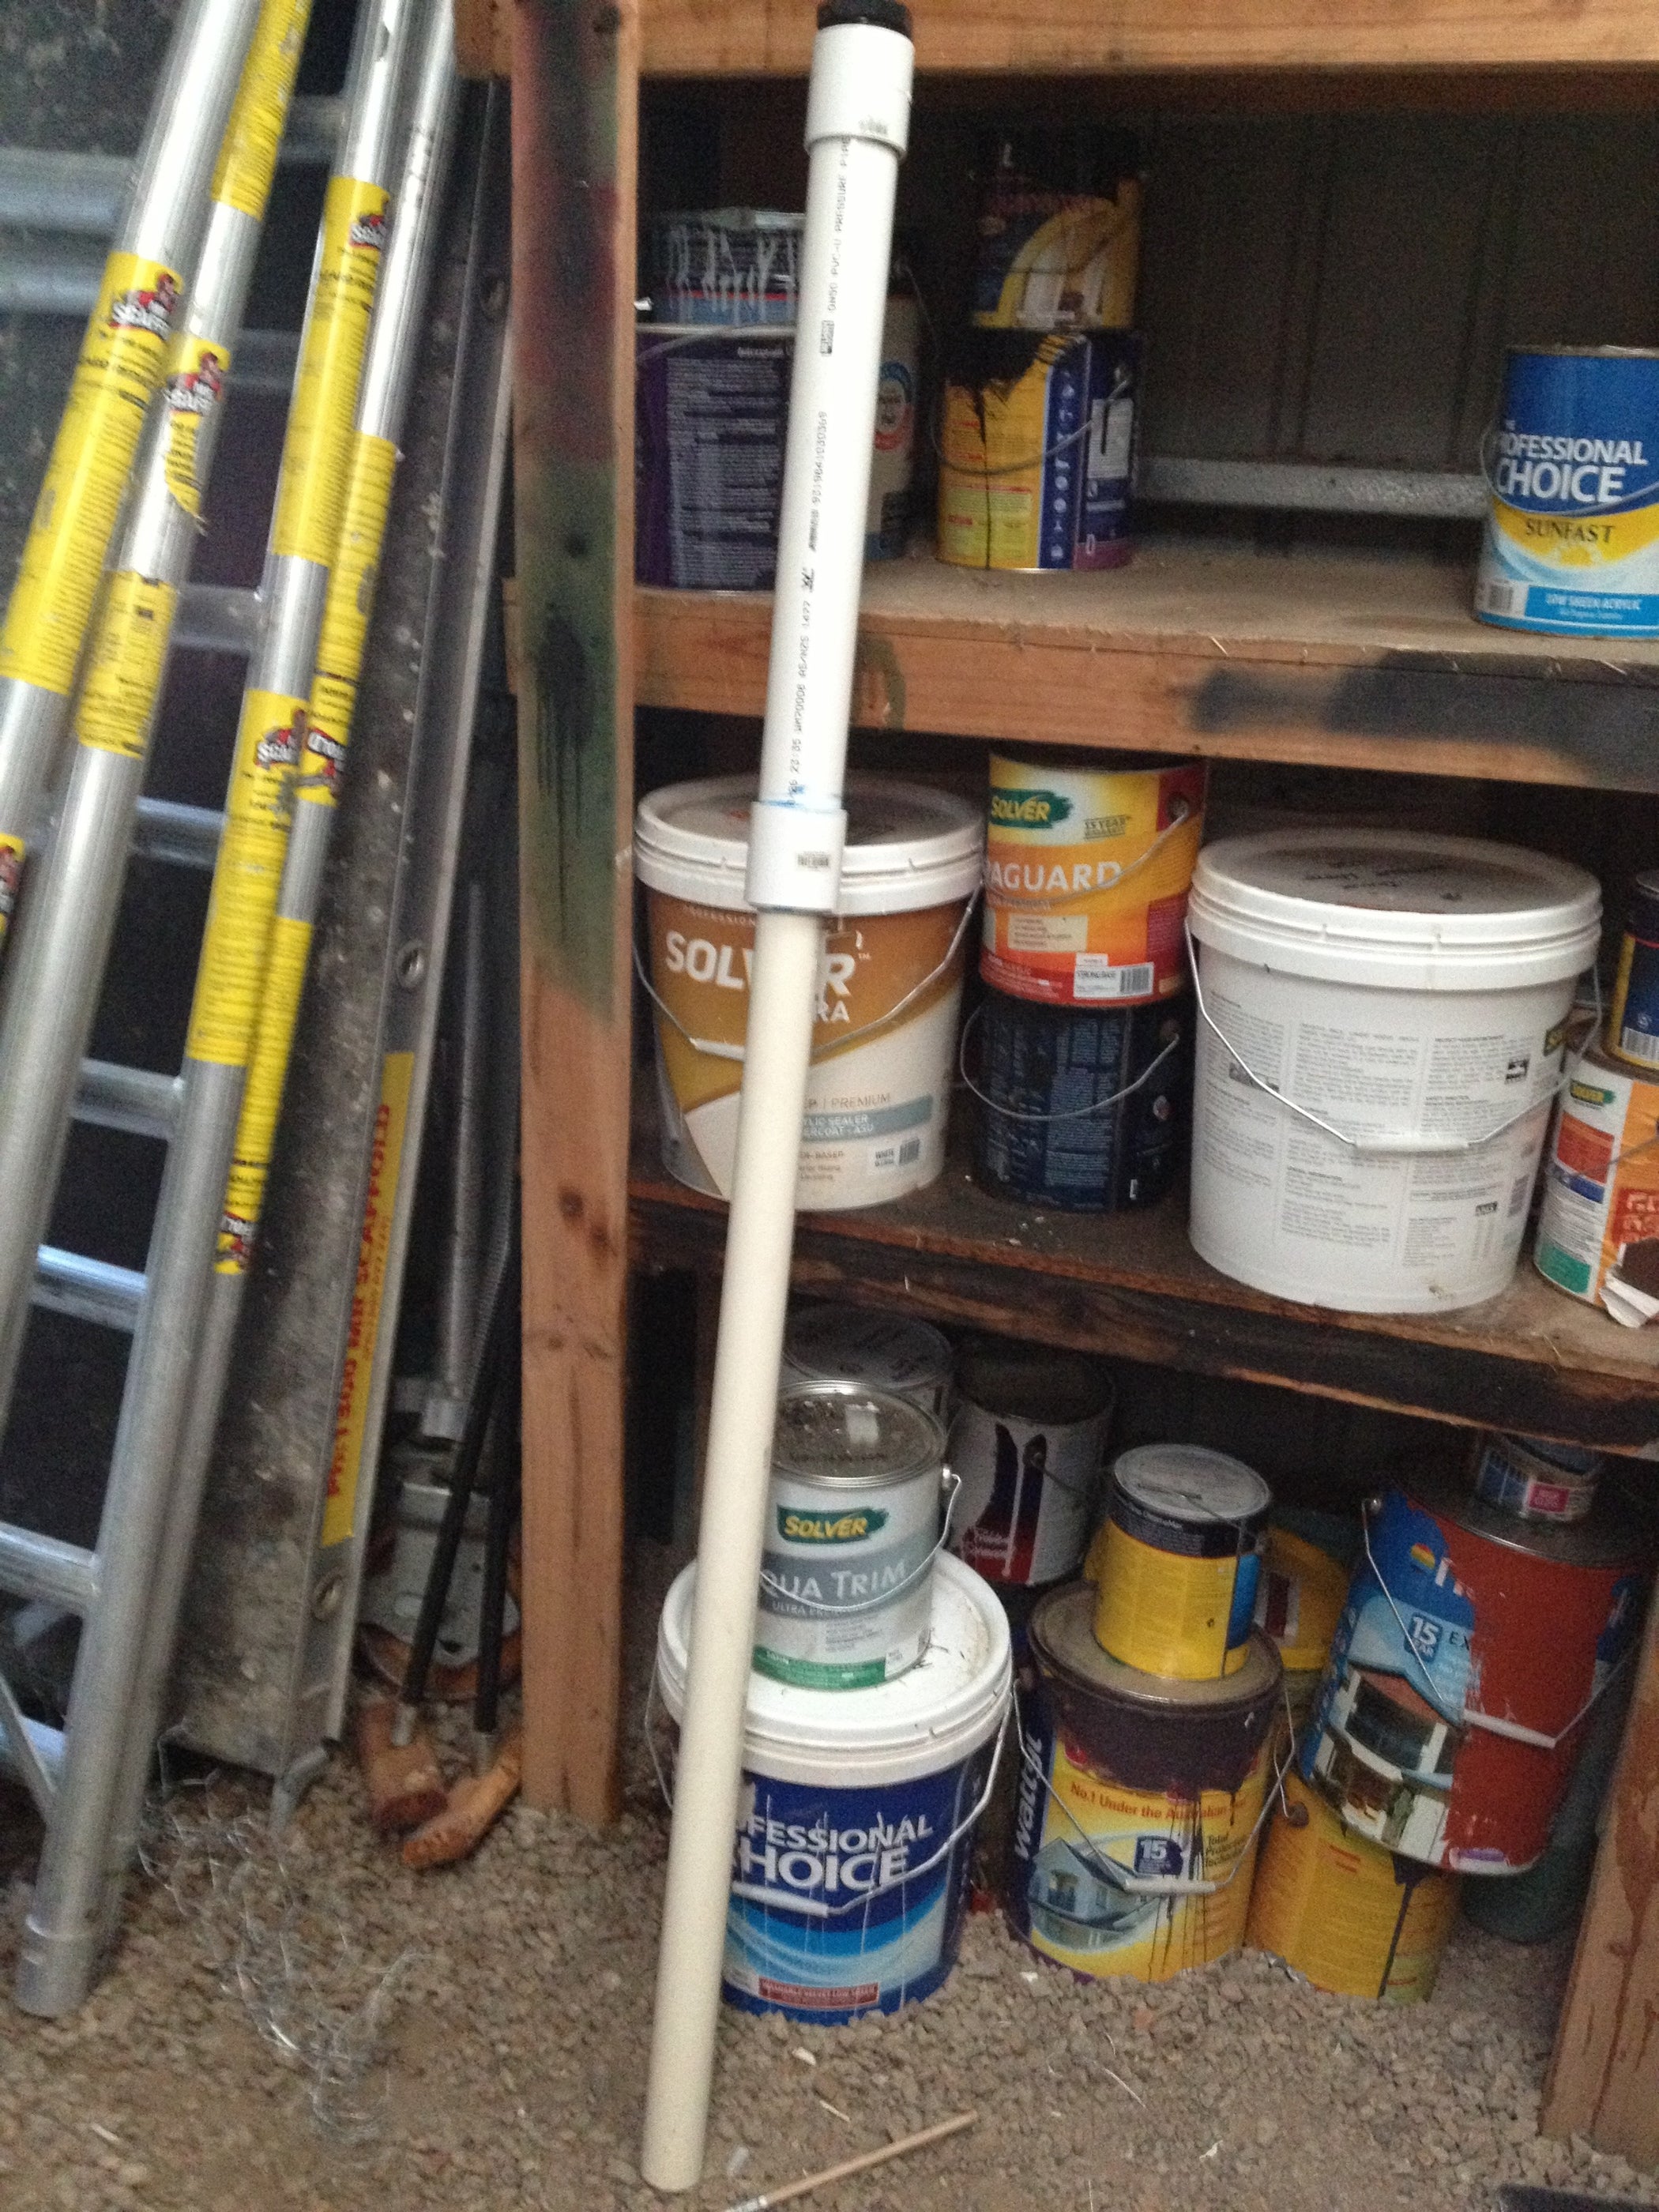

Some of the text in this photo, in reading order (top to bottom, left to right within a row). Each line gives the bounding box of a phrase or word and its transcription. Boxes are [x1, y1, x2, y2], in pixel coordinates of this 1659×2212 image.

[834, 175, 848, 232] PRESSURE
[1525, 518, 1616, 544] SUNFAST
[991, 795, 1051, 822] SOLVER
[989, 860, 1122, 891] AGUARD
[665, 929, 852, 998] SOLR
[831, 1093, 890, 1108] PREMIUM
[784, 1514, 868, 1539] SOLVER
[772, 1601, 806, 1616] ULTRA
[1412, 1616, 1439, 1646] 15
[1070, 1781, 1096, 1804] No.1
[1099, 1793, 1138, 1816] Under
[1142, 1806, 1162, 1819] the
[1138, 1839, 1168, 1858] 15
[739, 1836, 910, 1891] HOICE
